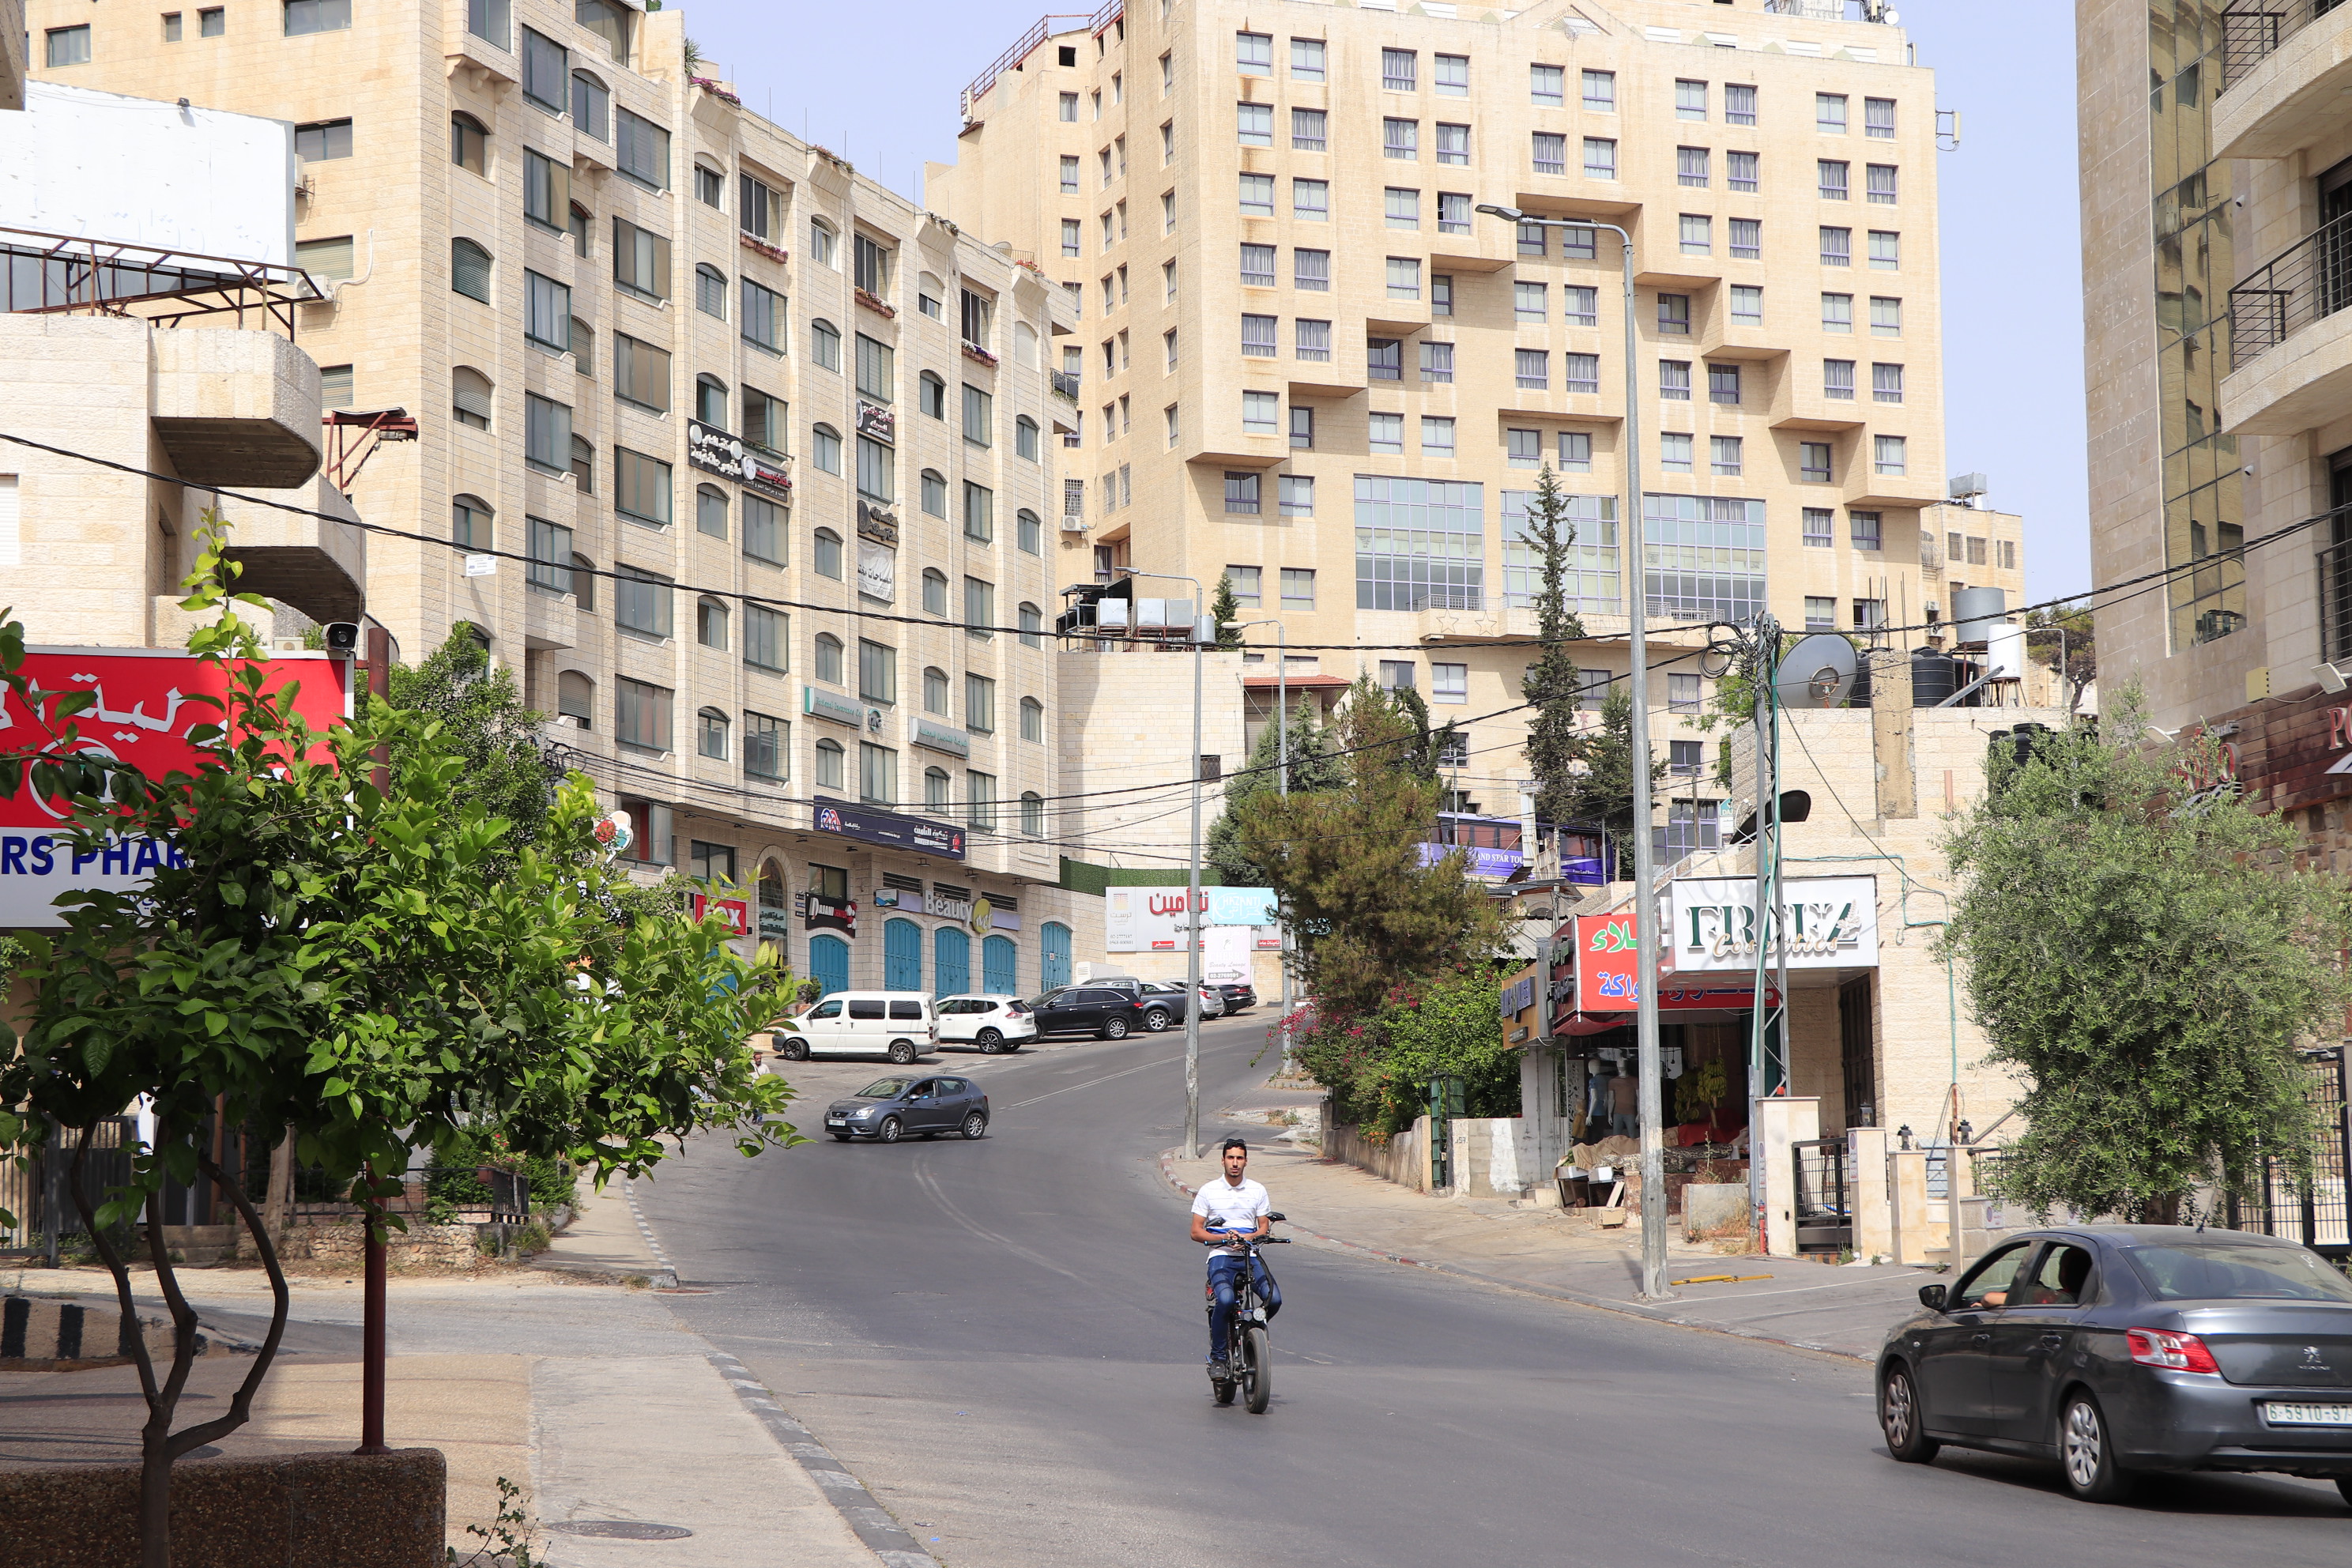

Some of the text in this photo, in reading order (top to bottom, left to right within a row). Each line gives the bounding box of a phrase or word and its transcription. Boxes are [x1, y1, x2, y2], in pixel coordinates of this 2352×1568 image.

[71, 835, 189, 875] PHAR
[1476, 852, 1524, 865] AND STAR TOU
[925, 889, 973, 927] Beauty
[1686, 903, 1861, 948] FREZ
[1589, 920, 1638, 953] لاء
